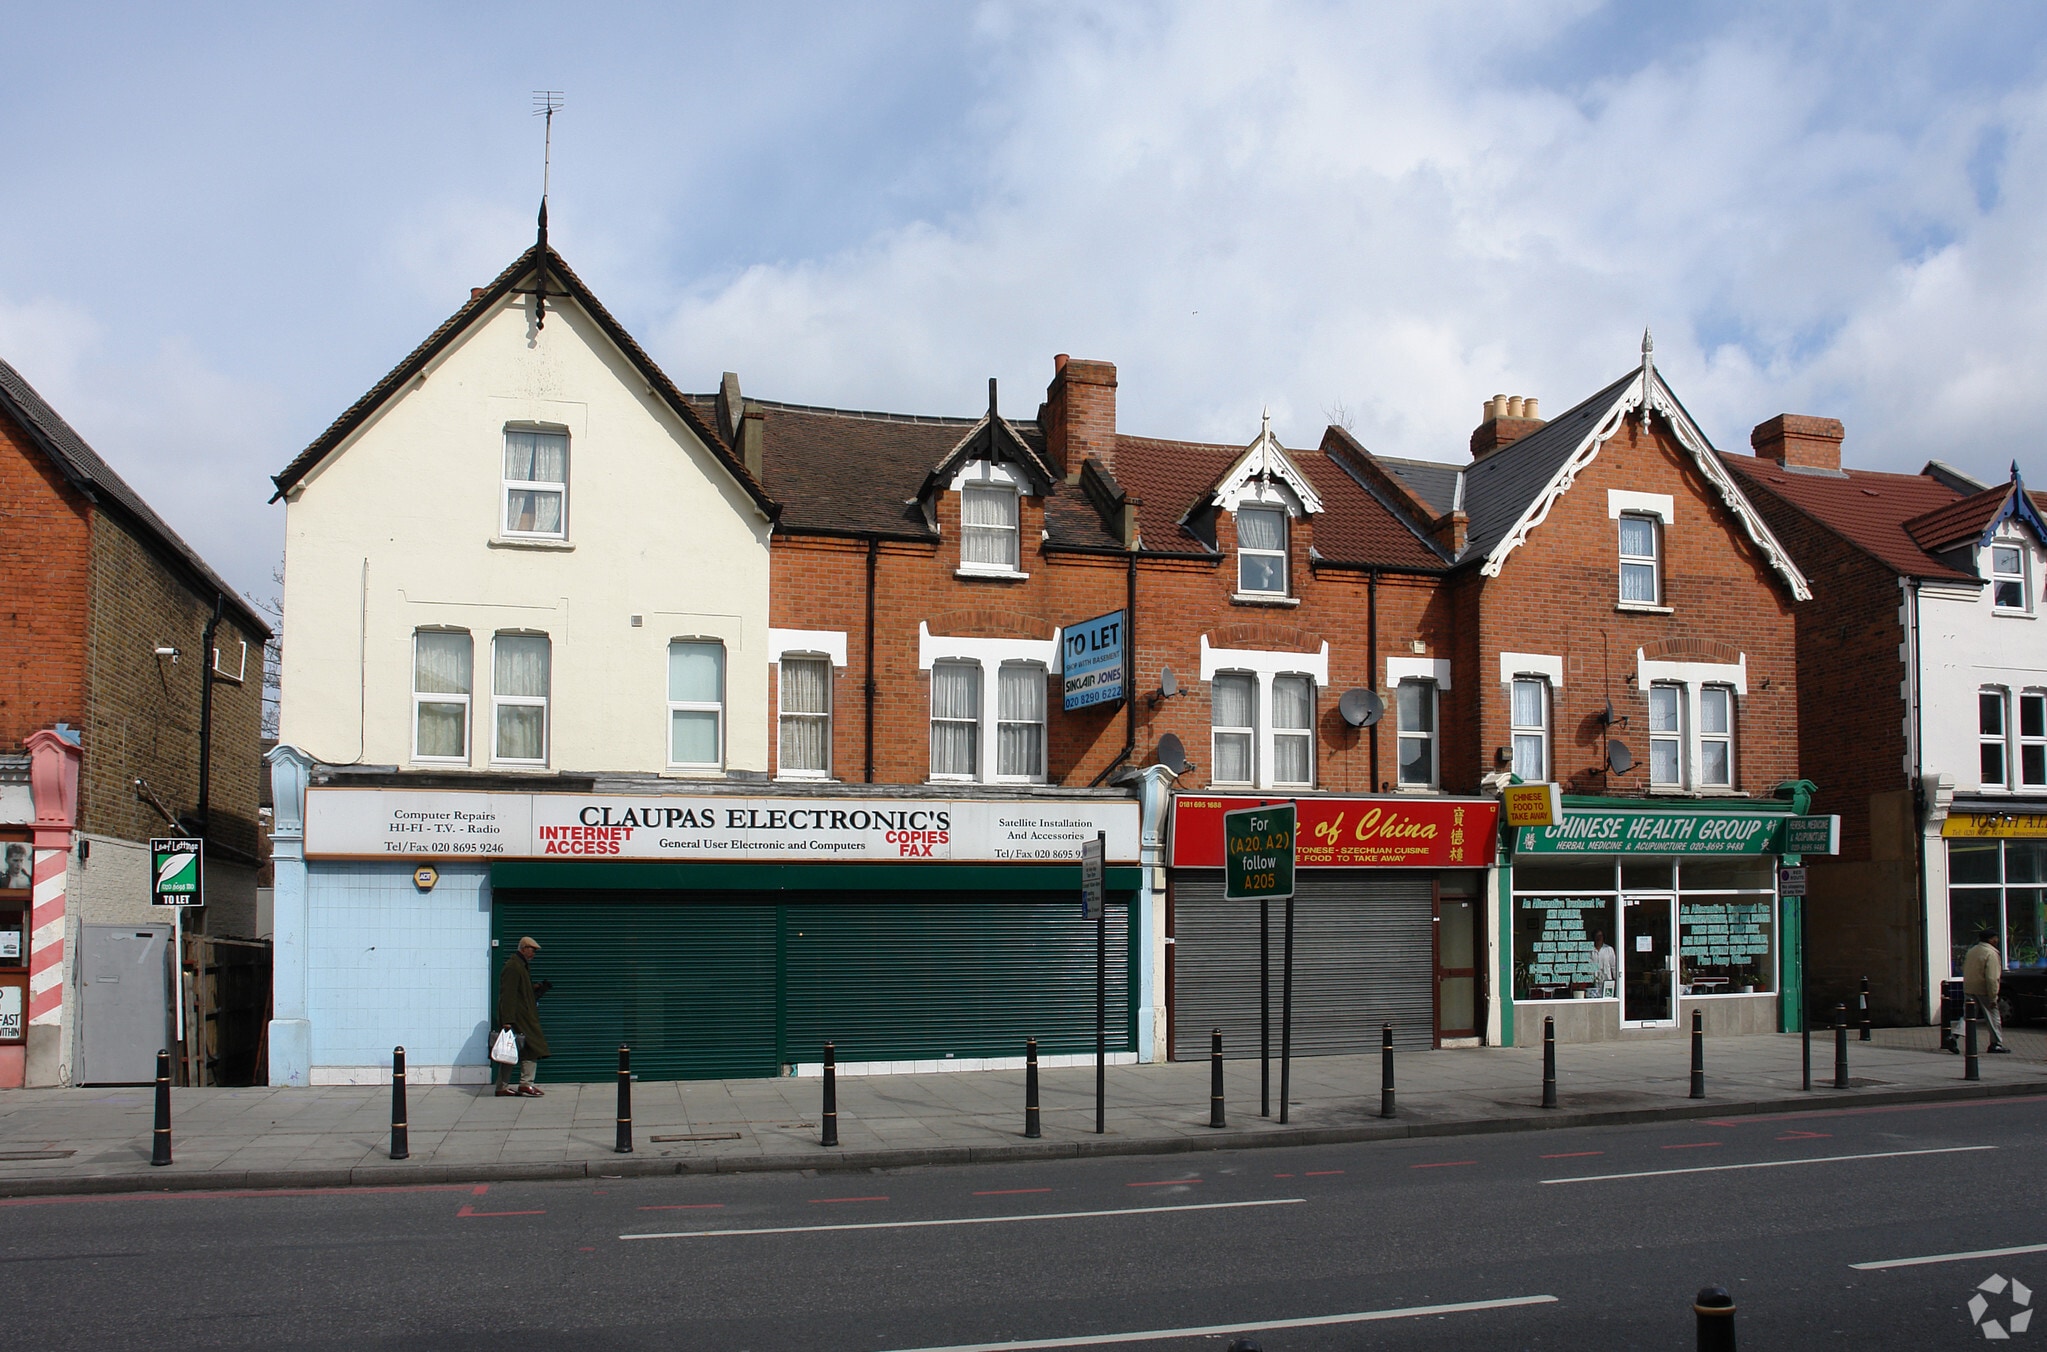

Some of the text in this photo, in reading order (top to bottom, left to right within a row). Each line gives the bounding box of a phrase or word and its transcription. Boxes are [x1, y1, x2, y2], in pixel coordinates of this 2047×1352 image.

[1066, 622, 1119, 658] TO LET
[1078, 657, 1092, 668] WITH
[1092, 650, 1120, 664] BASEMENT
[1065, 667, 1121, 693] SINCLAIR JONES
[1065, 685, 1122, 709] 020 8290 6222
[1512, 792, 1543, 801] CHINESE
[1513, 802, 1544, 811] FOOD TO
[394, 810, 496, 822] Computer Repairs
[579, 806, 950, 831] CLAUPAS ELECTRONIC'S
[1510, 811, 1548, 821] TAKE AWAY
[388, 823, 423, 833] HI-FI
[434, 823, 456, 833] T.V.
[467, 824, 501, 834] Radio
[998, 818, 1093, 828] Satellite Installation
[1250, 817, 1269, 832] For
[1314, 811, 1345, 846] of
[1355, 807, 1439, 841] China
[1626, 816, 1697, 839] HEALTH
[1698, 819, 1762, 840] GROUP
[1789, 819, 1829, 830] HERBAL MEDICINE
[539, 826, 634, 841] INTERNET
[885, 830, 949, 844] COPIES
[1007, 831, 1085, 840] And Accessories
[1794, 831, 1828, 842] ACUPUNCTURE
[154, 840, 199, 853] Leaf Lettings
[384, 841, 504, 853] Tel/Fax 020 8695 9246
[659, 838, 866, 852] General User Electronic and Computers
[1265, 831, 1290, 850] A2)
[1556, 840, 1585, 850] HERBAL
[1587, 841, 1623, 850] MEDICINE
[1635, 842, 1687, 850] ACUPUNCTURE
[1690, 842, 1725, 851] 020-8695
[1726, 842, 1745, 851] 9488
[544, 840, 621, 855] ACCESS
[899, 844, 933, 857] FAX
[994, 848, 1033, 859] Tel/Fax
[1034, 849, 1050, 859] 020
[1052, 849, 1073, 859] 8695
[1297, 846, 1334, 854] TONESE
[1341, 847, 1393, 855] SZECHUAN
[1394, 847, 1430, 855] CUISINE
[1242, 855, 1277, 871] follow
[1304, 854, 1332, 862] FOOD
[1244, 873, 1275, 890] A205
[163, 895, 190, 904] TO LET
